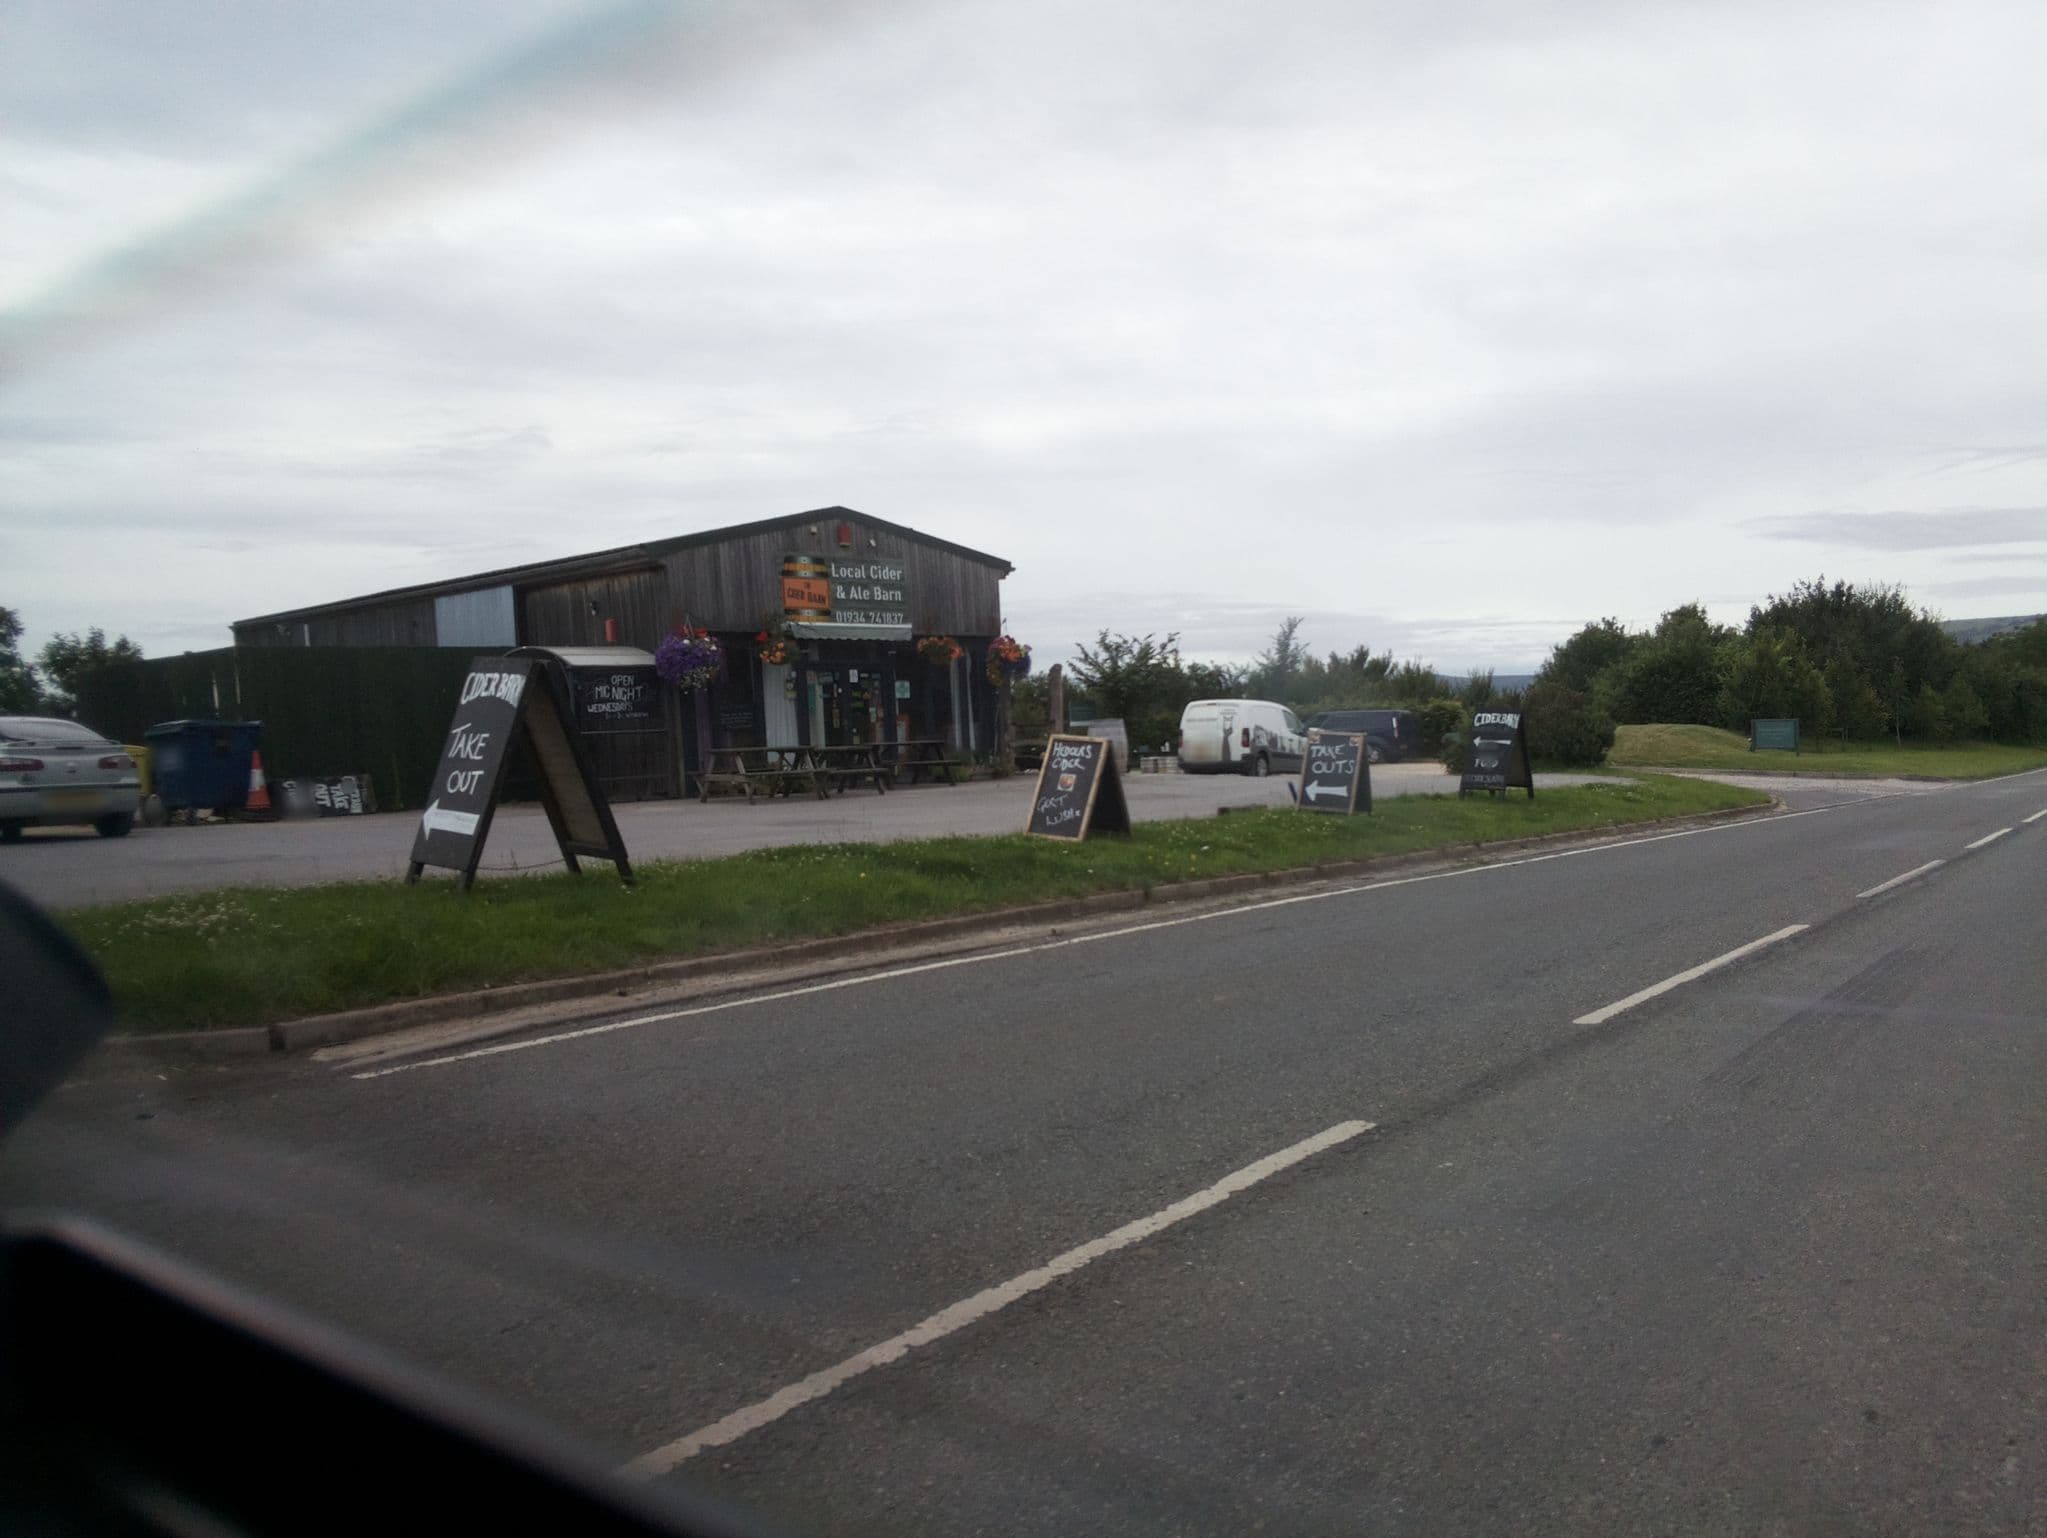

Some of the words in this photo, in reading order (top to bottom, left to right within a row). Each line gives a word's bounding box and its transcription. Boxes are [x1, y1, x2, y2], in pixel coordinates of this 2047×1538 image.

[831, 563, 866, 579] Local
[870, 565, 902, 581] Cider
[836, 585, 846, 599] &
[849, 585, 870, 600] Ale
[873, 586, 902, 601] Barn
[836, 611, 866, 623] 01934
[611, 675, 634, 686] OPEN
[595, 686, 610, 699] MIC
[611, 686, 643, 700] NIGHT
[448, 723, 490, 760] TAKE
[1311, 744, 1346, 759] TAKE
[1312, 760, 1355, 774] OUTS
[447, 771, 484, 795] OUT
